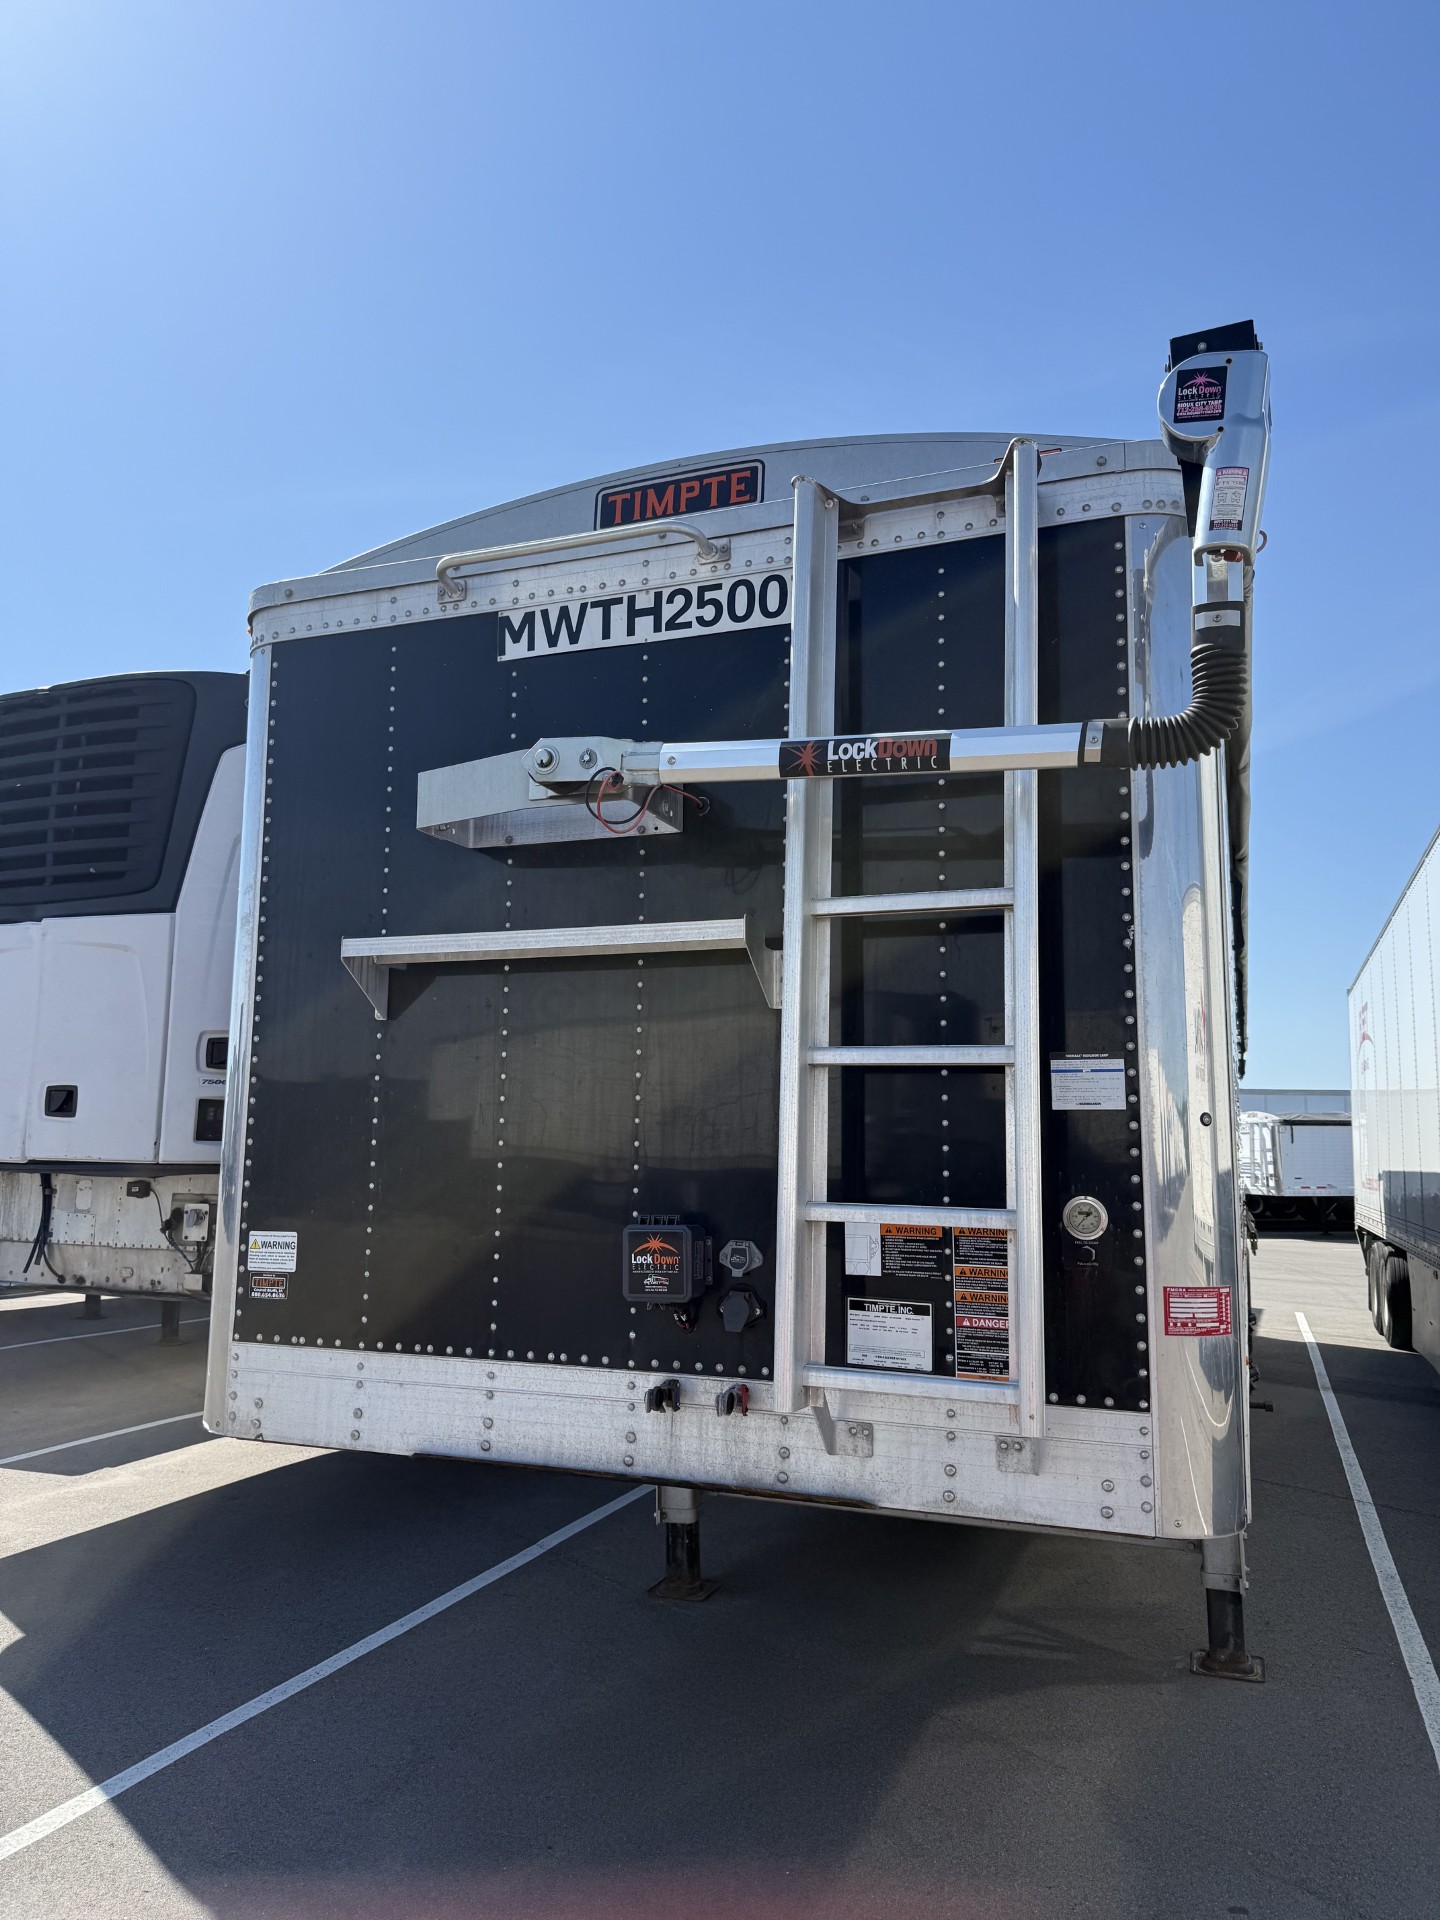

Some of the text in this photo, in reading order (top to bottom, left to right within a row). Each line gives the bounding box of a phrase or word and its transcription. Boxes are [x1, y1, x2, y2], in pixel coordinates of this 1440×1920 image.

[1178, 386, 1221, 395] Lock Down
[608, 470, 752, 525] TIMPTE
[500, 574, 788, 657] MWTH2500
[828, 755, 937, 772] ELECTRIC
[896, 1227, 937, 1235] WARNING
[261, 1240, 296, 1250] WARNING
[632, 1254, 679, 1264] Lock Down
[255, 1278, 283, 1287] TIMPTE
[970, 1294, 1008, 1302] WARNIN
[898, 1306, 914, 1315] INC.
